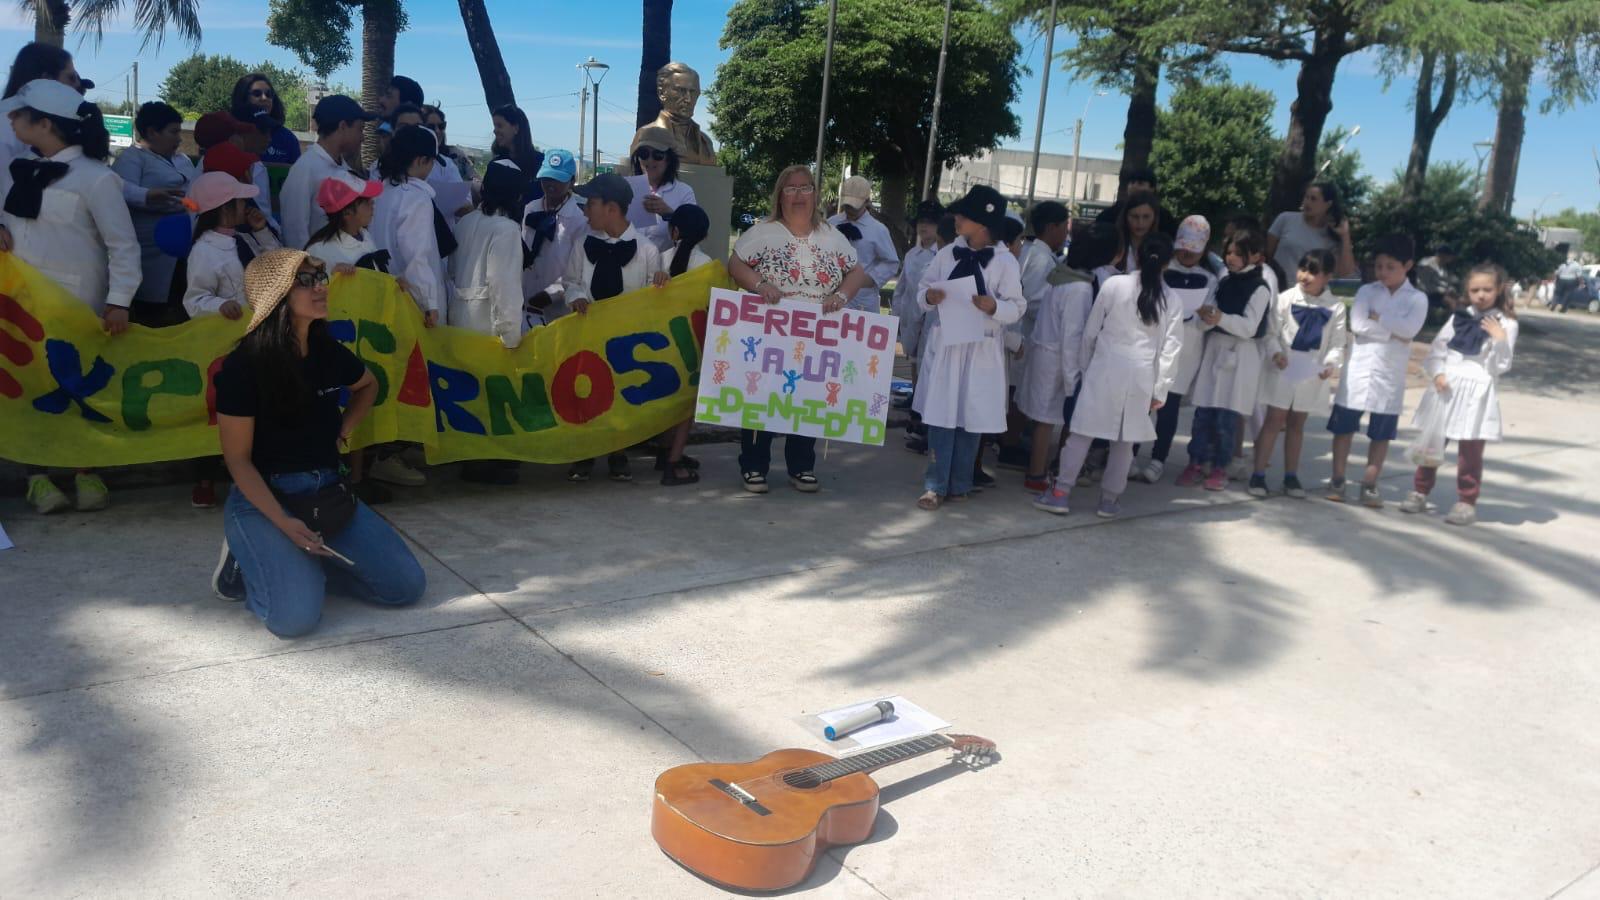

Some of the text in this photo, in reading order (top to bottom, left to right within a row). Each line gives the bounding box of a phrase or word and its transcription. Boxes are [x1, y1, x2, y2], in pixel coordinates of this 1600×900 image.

[712, 294, 890, 351] DERECHO
[761, 347, 841, 383] A LA
[696, 385, 885, 444] IDENTIDAD
